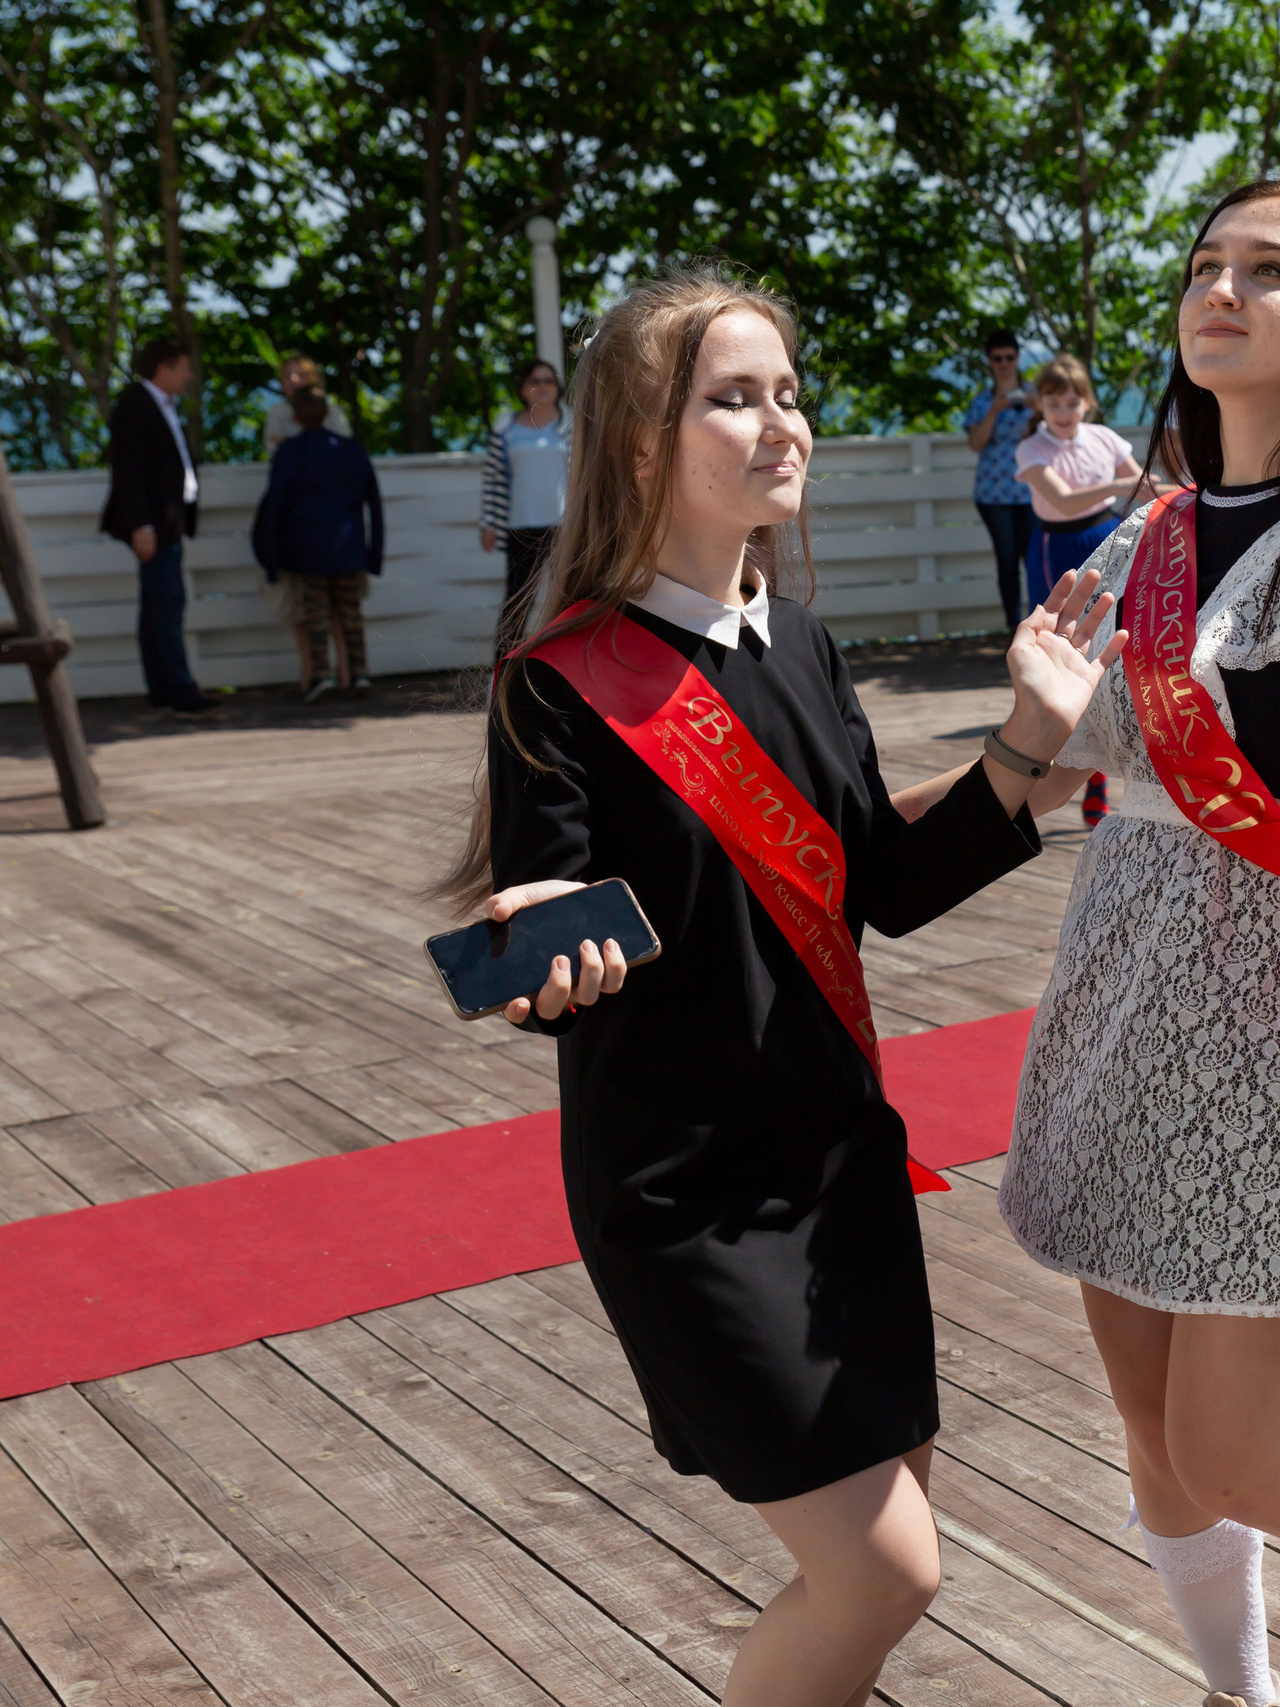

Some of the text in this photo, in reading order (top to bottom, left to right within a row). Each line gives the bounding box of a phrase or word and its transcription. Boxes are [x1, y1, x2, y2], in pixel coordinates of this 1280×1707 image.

[1138, 544, 1153, 582] школа
[1135, 582, 1148, 610] №9
[1132, 613, 1143, 654] класс
[1134, 655, 1147, 674] 11
[685, 696, 845, 921] Выпуск
[708, 793, 751, 850] школа
[774, 882, 807, 927] класс
[804, 924, 822, 944] 11
